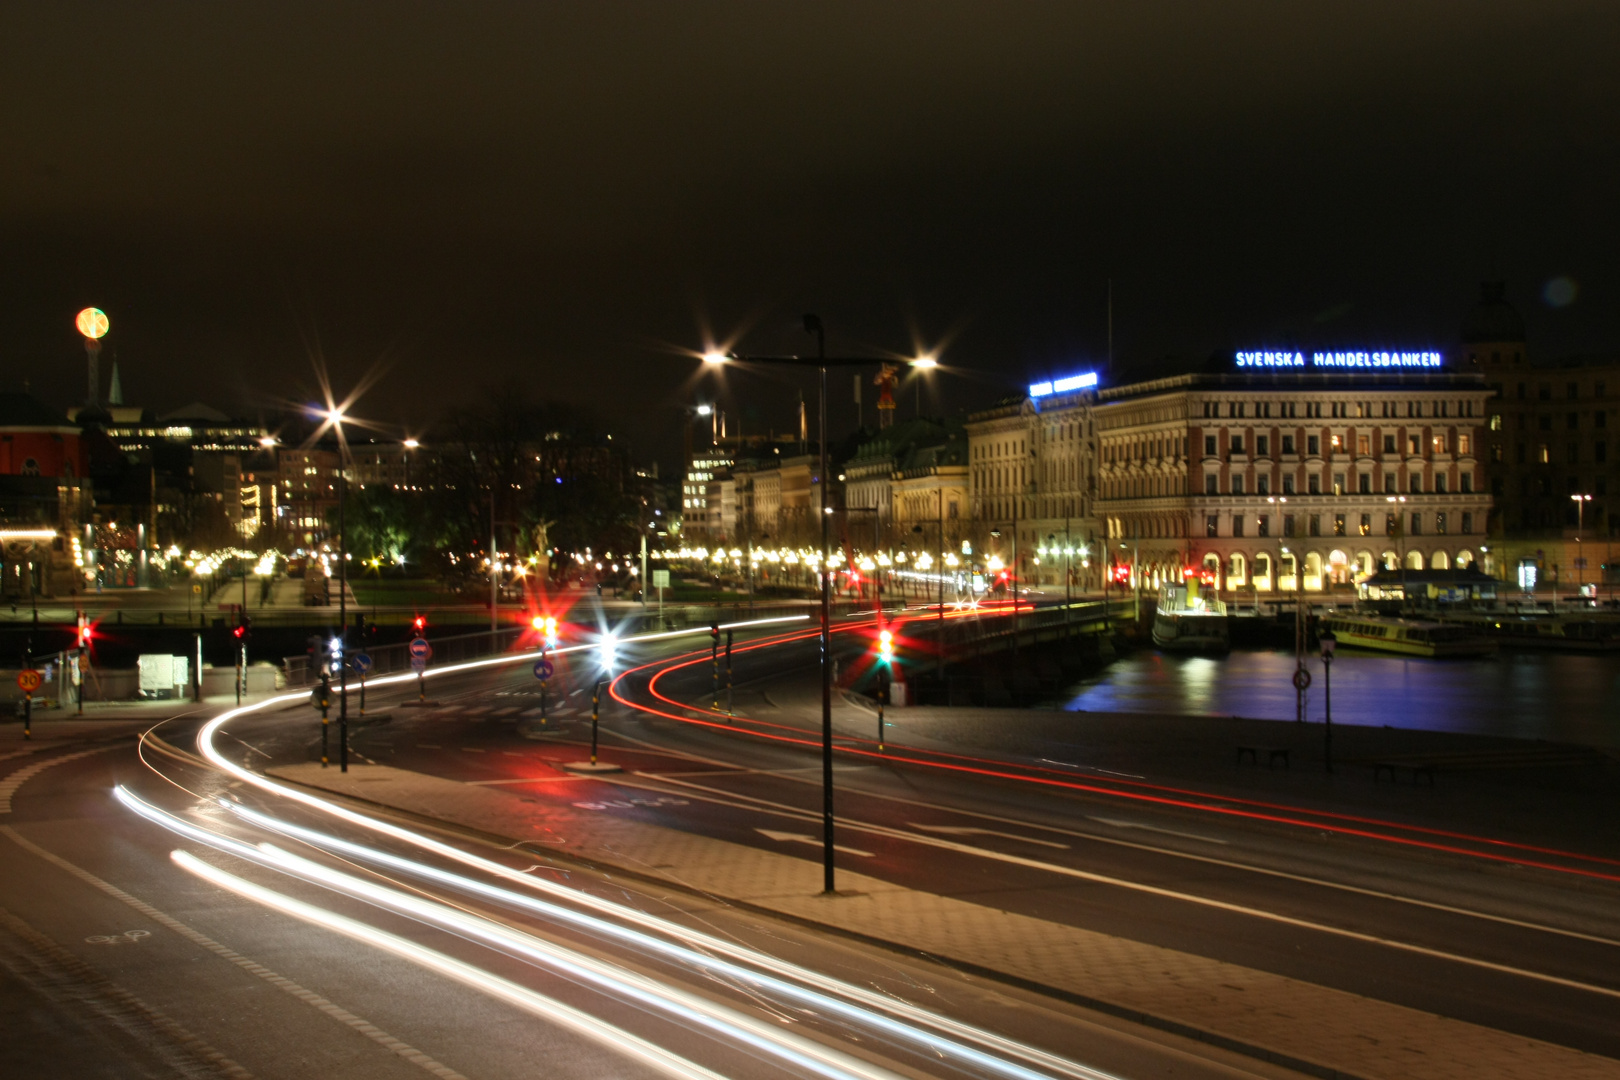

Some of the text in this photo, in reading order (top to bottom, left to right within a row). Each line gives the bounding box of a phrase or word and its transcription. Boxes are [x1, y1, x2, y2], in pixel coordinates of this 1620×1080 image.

[1236, 352, 1440, 367] SVENSKA HANDELSBANKEN
[21, 674, 38, 686] 30
